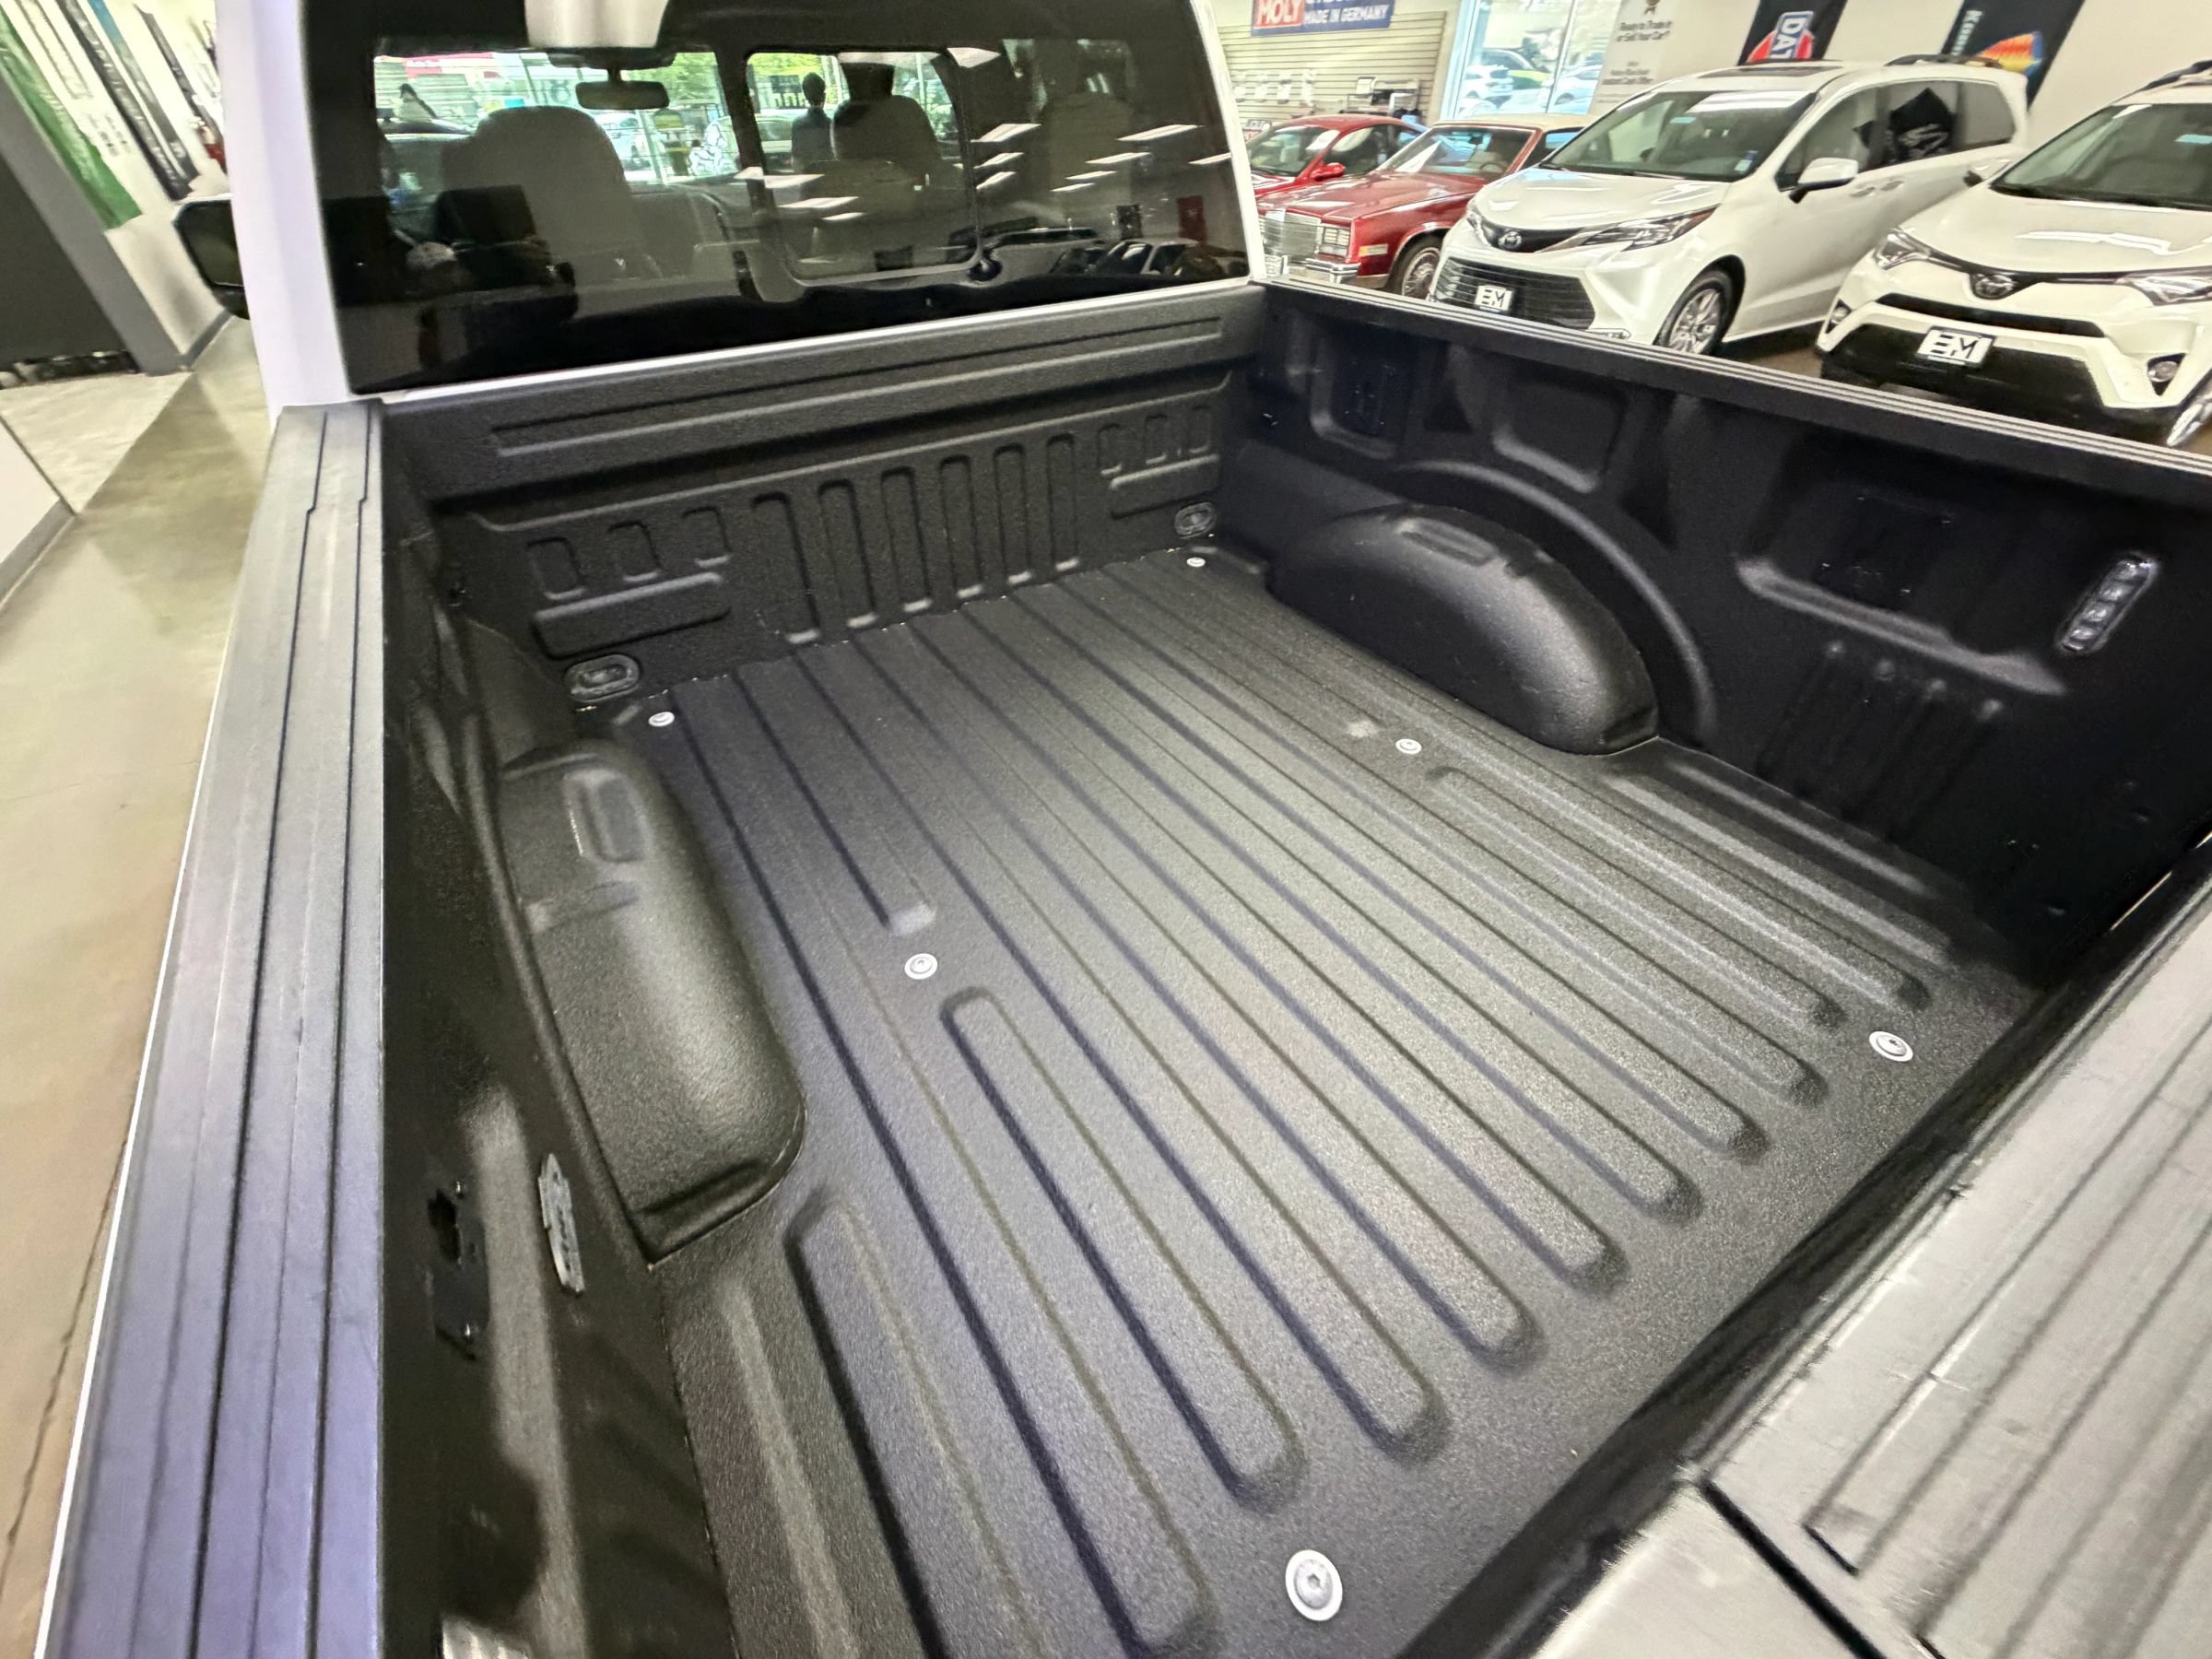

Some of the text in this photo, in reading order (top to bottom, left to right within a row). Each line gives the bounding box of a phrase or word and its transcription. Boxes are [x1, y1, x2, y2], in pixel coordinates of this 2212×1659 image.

[1255, 0, 1300, 25] MOLY
[1304, 5, 1390, 24] MADE IN GERMANY
